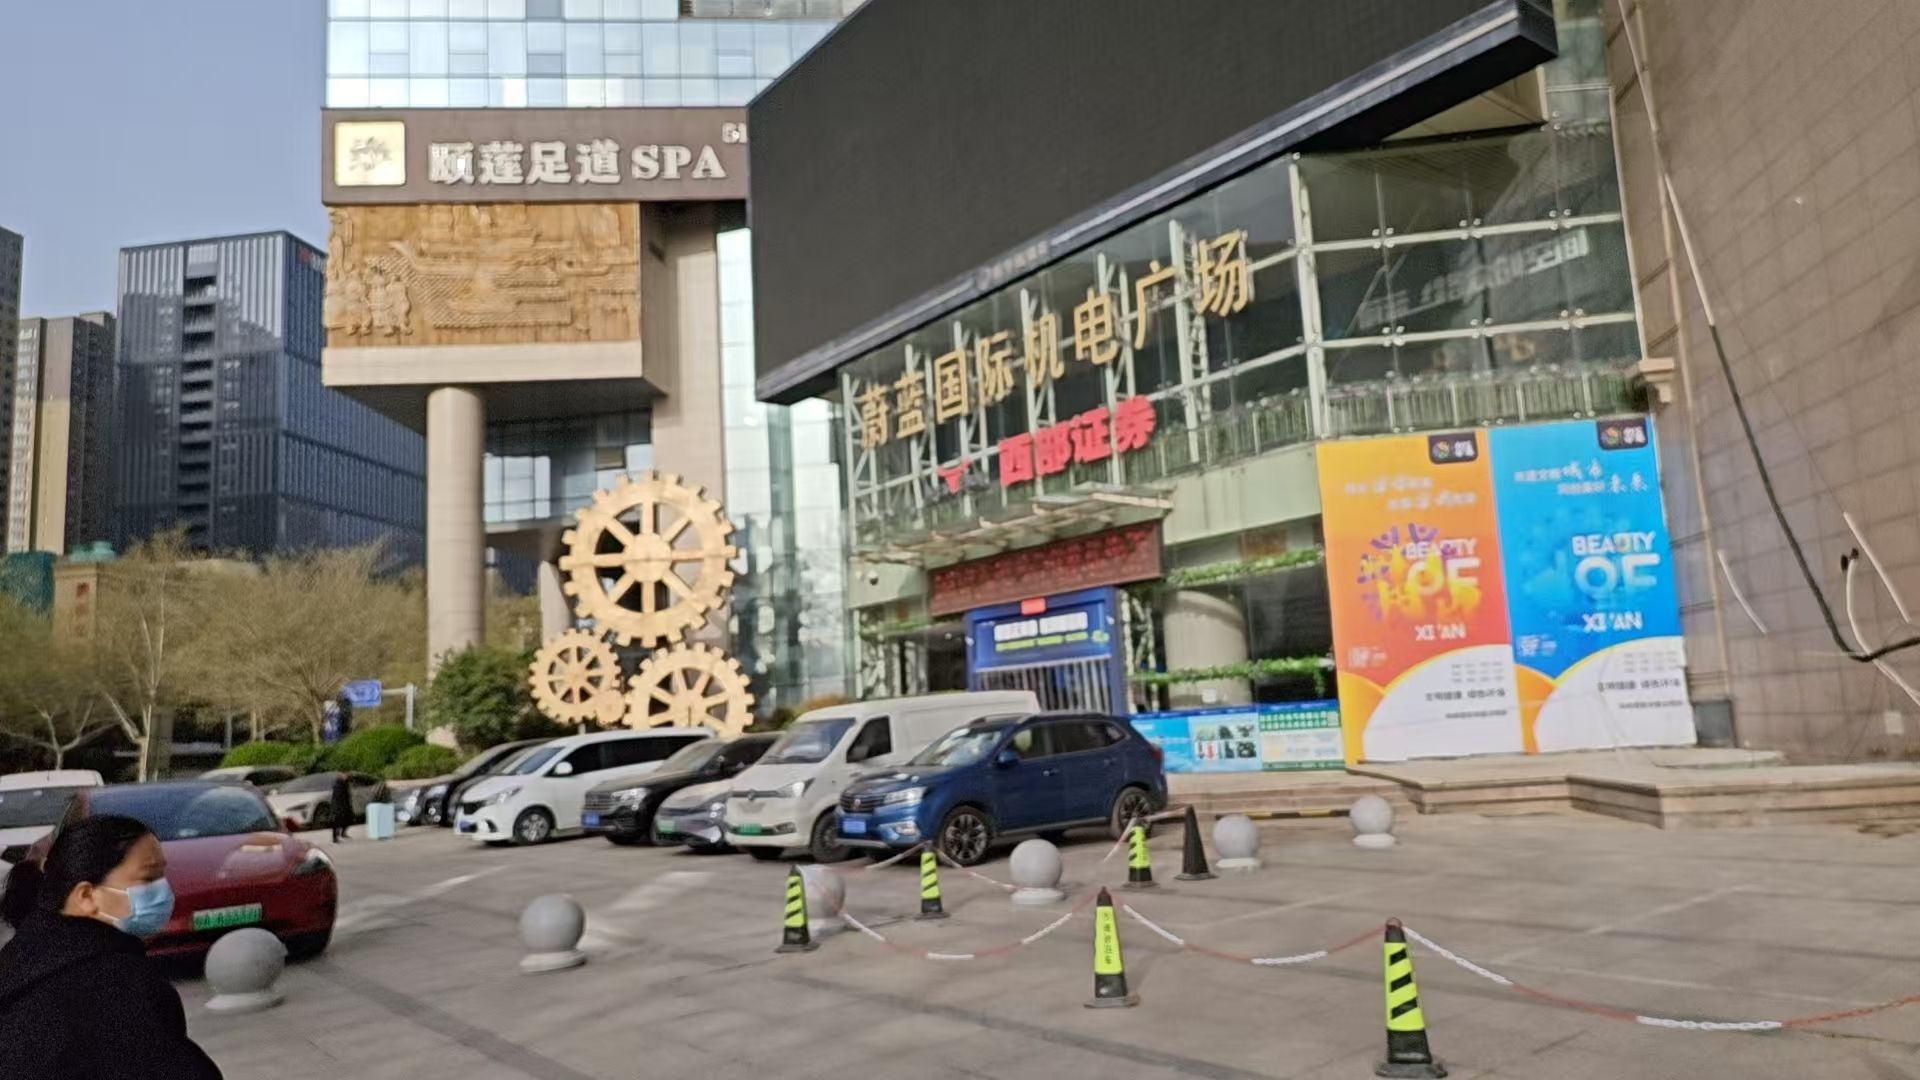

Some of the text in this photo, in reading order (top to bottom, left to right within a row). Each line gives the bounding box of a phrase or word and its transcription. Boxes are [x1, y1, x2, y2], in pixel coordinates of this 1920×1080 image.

[427, 138, 727, 185] 颐莲足道 SPA
[857, 228, 1250, 449] 蔚蓝国际机电广场
[997, 394, 1157, 487] 西部证券
